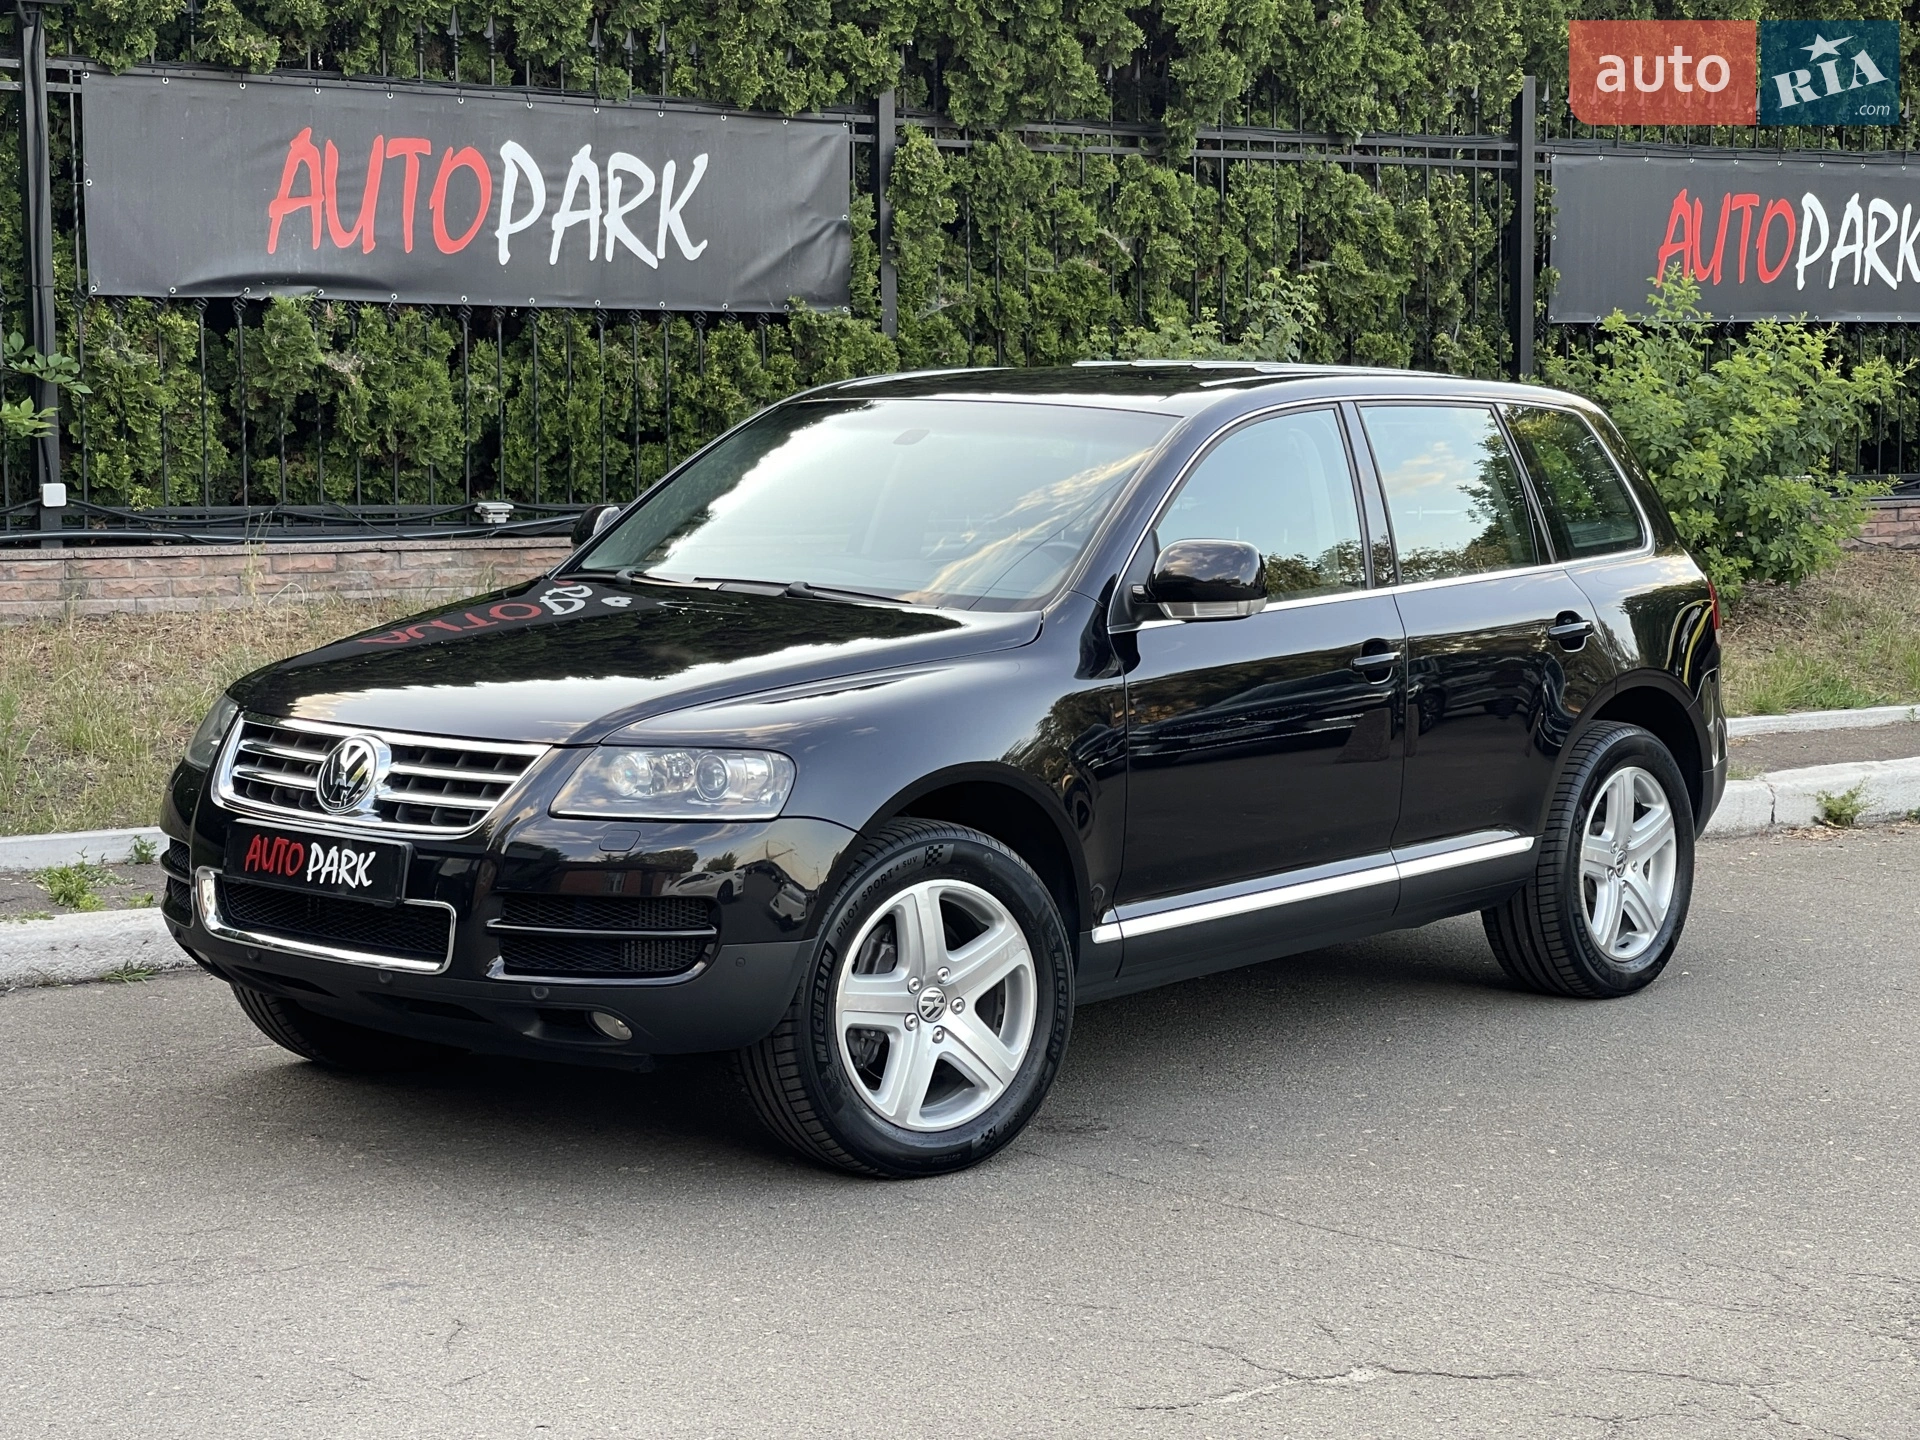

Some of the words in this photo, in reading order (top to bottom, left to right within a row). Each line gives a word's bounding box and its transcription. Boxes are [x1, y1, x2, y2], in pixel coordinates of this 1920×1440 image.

[836, 902, 860, 938] PILOT
[862, 868, 895, 901] SPORT
[902, 855, 919, 868] SUV
[812, 949, 836, 1064] MICHELIN
